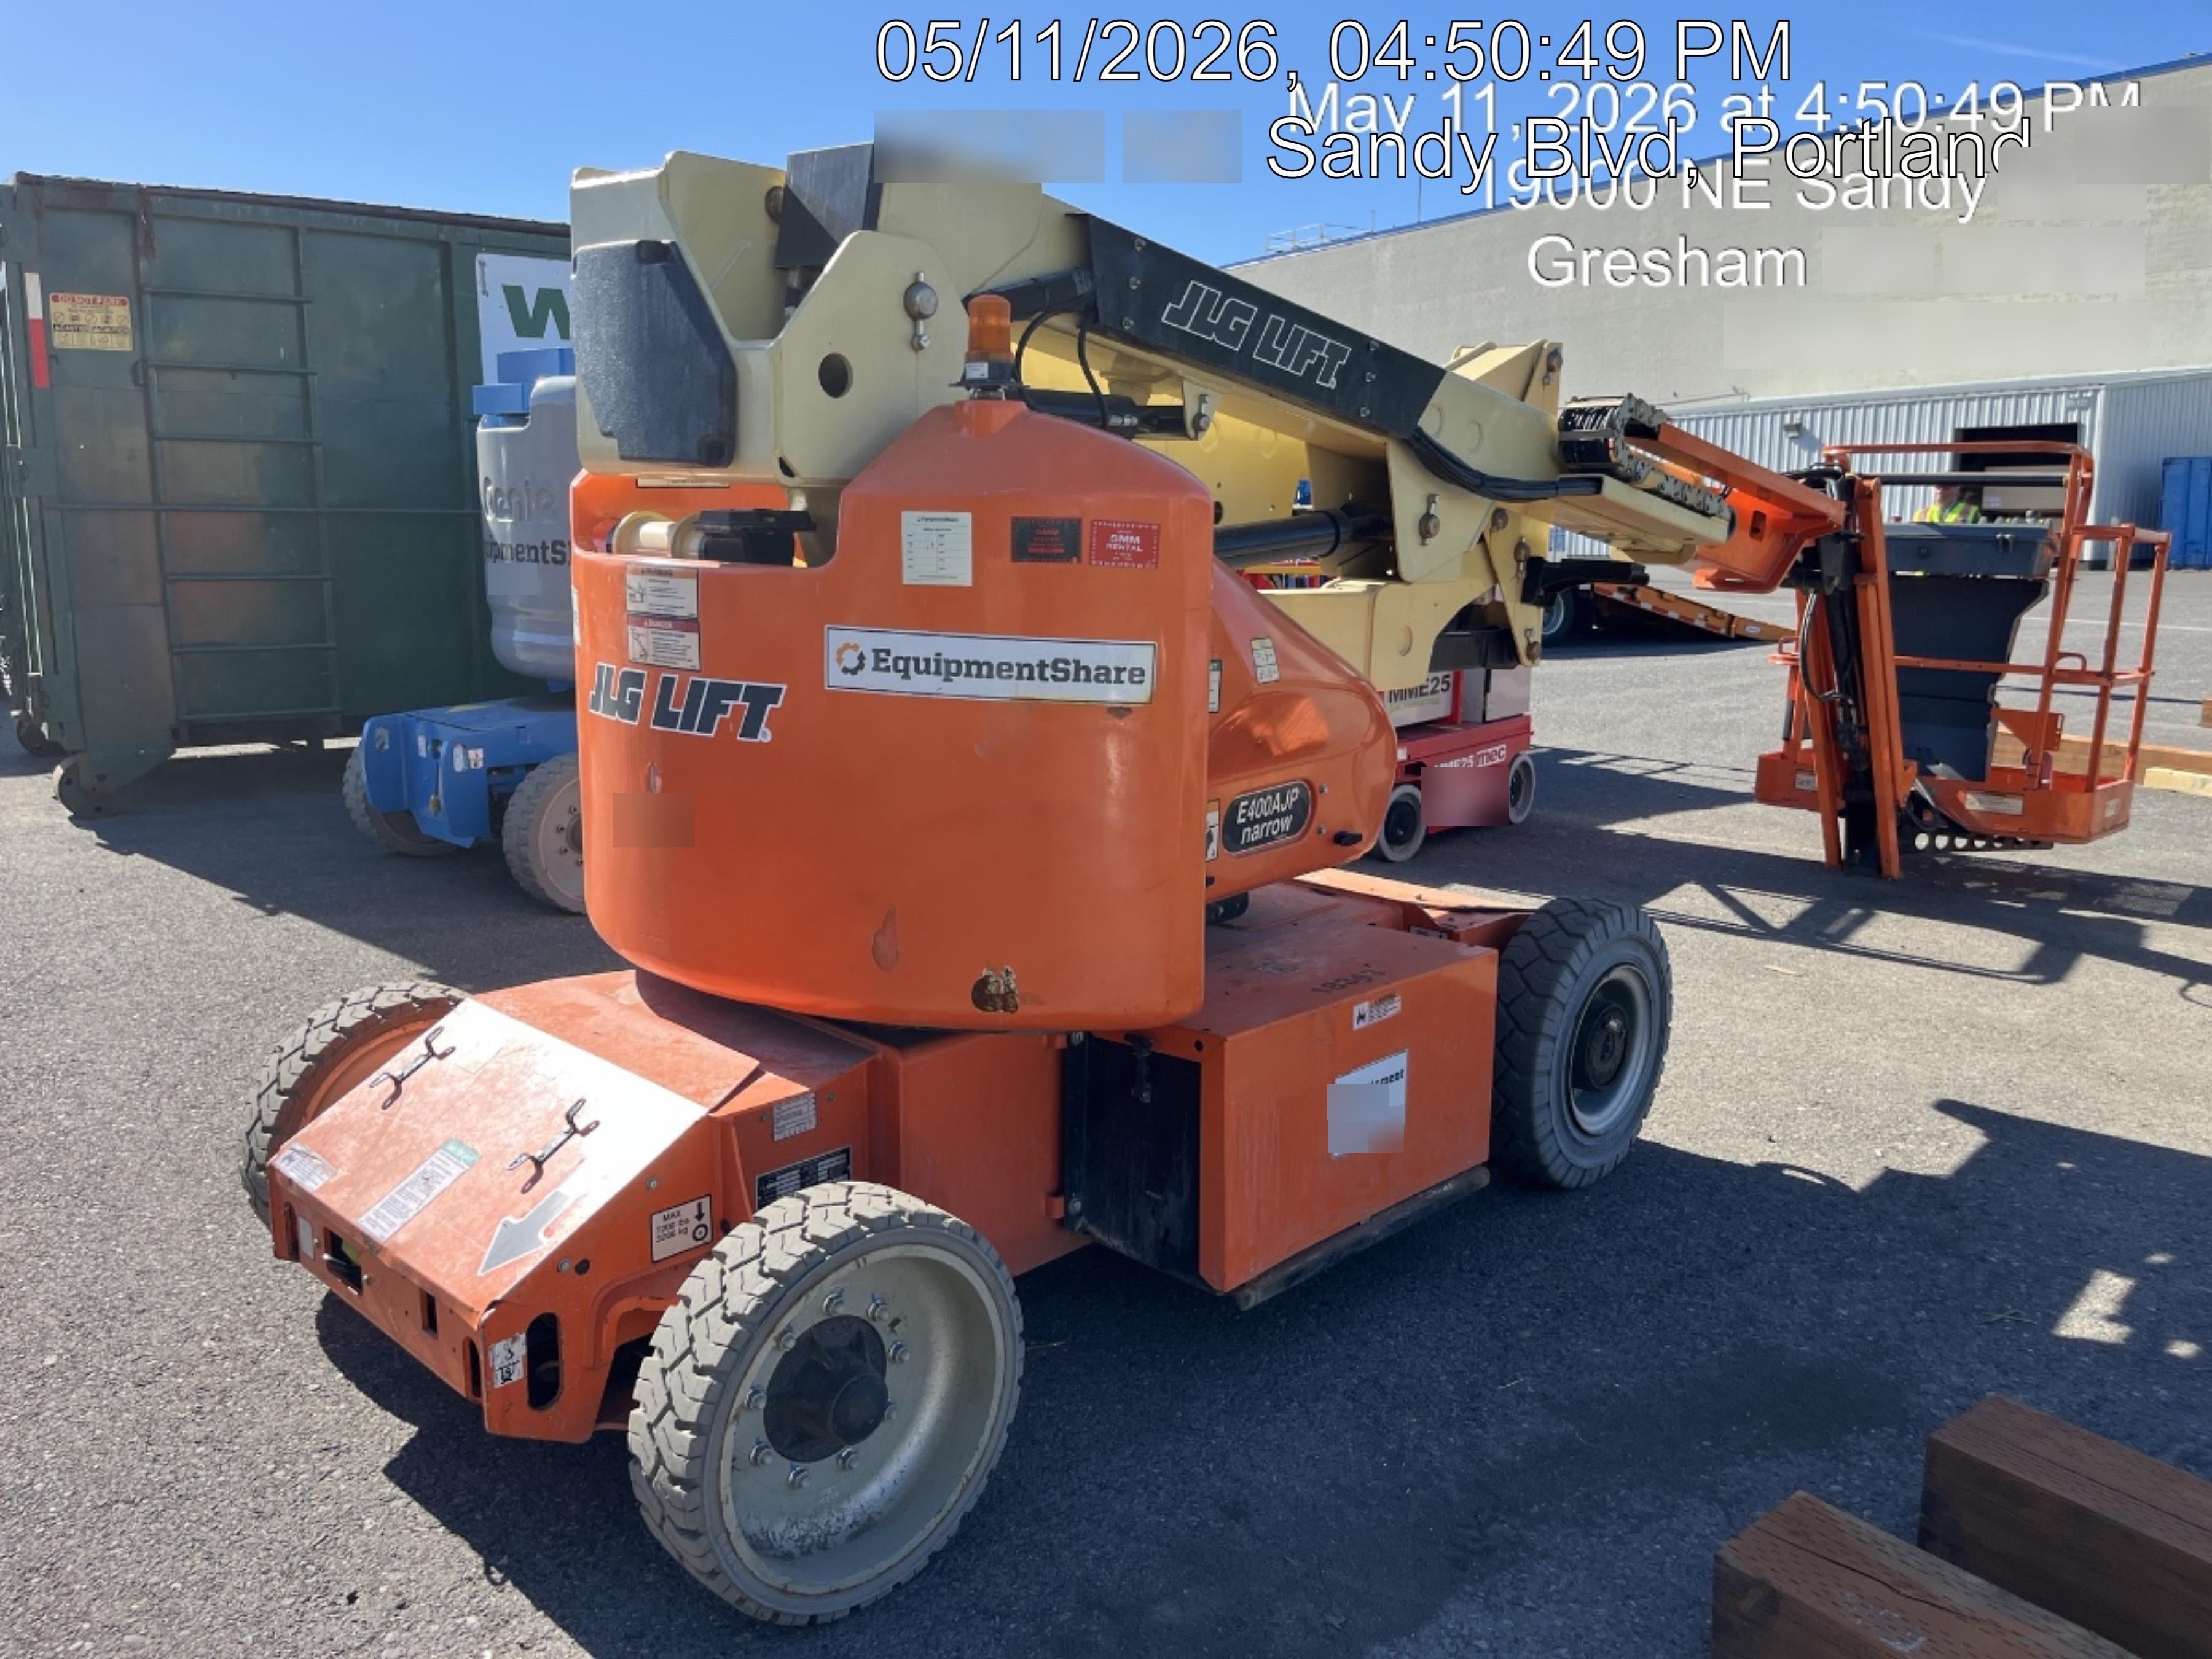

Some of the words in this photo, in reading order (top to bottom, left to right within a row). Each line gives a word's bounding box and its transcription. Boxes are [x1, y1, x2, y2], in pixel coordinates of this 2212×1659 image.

[1161, 280, 1258, 351] JLG
[1252, 314, 1352, 390] LIFT
[871, 647, 1146, 686] EquipmentShare
[589, 662, 648, 725] JLG
[650, 673, 788, 742] LIFT
[1237, 787, 1300, 825] E400AJP
[1240, 814, 1293, 845] narrow
